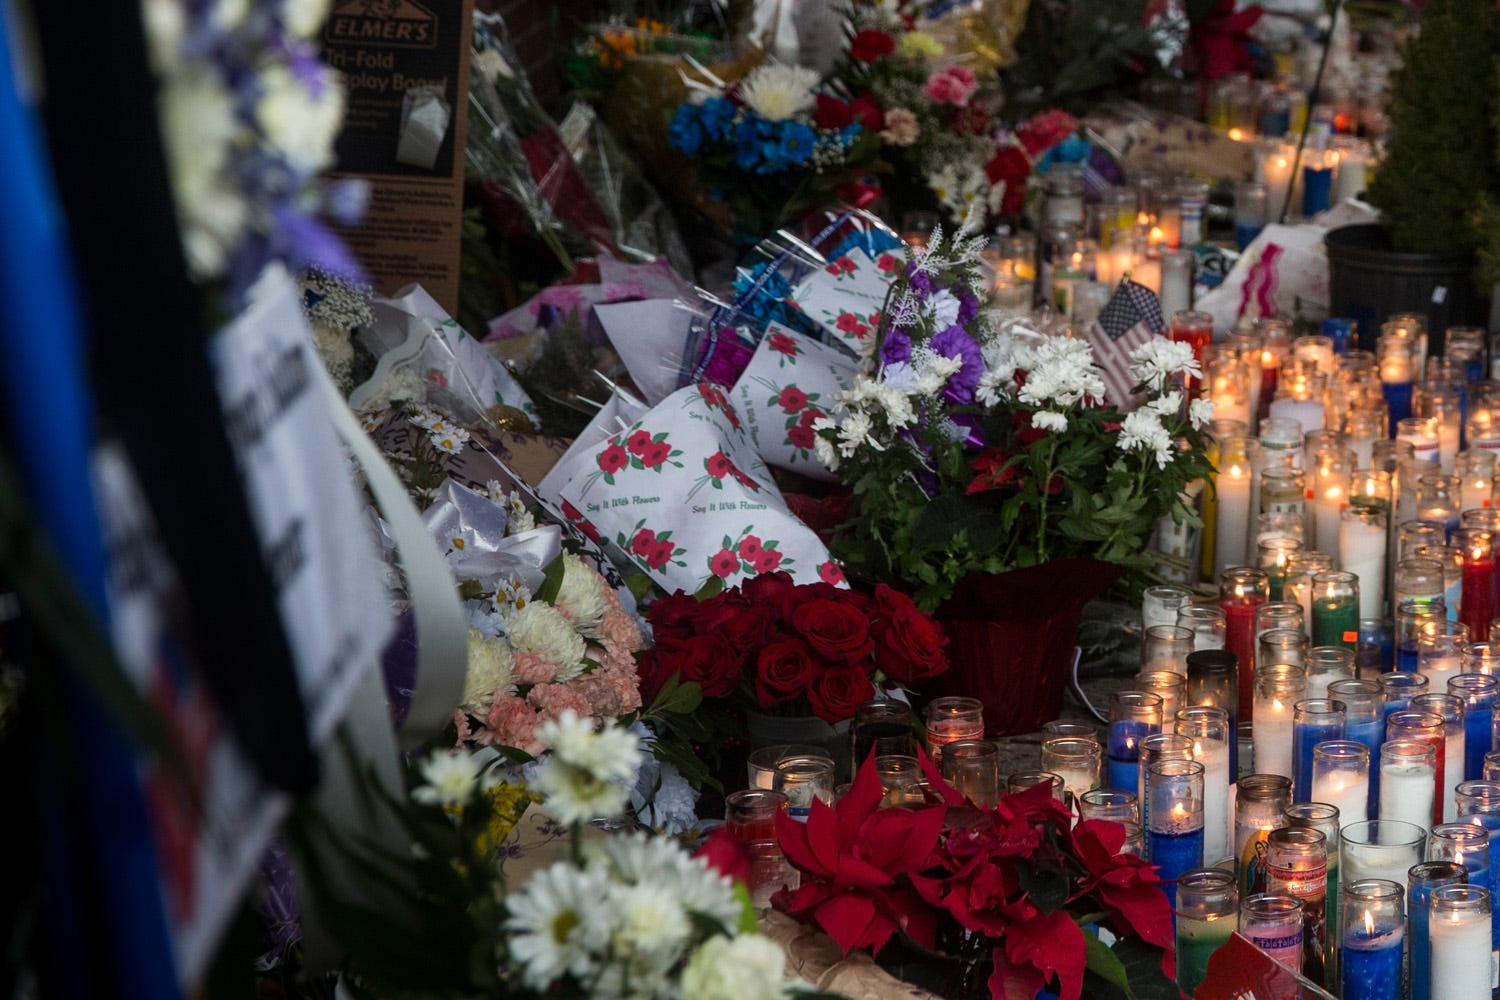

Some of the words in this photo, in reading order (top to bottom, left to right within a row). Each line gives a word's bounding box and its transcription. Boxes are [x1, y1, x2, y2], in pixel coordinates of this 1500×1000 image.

[334, 18, 430, 41] ELMER'S
[325, 49, 395, 69] Tri-Fold
[343, 73, 389, 93] splay
[586, 503, 600, 512] Say
[602, 499, 609, 509] It
[612, 496, 629, 508] With
[632, 495, 660, 505] Flowers
[692, 505, 706, 514] Say
[709, 503, 716, 511] It
[719, 501, 736, 511] With
[740, 501, 767, 510] Flowers
